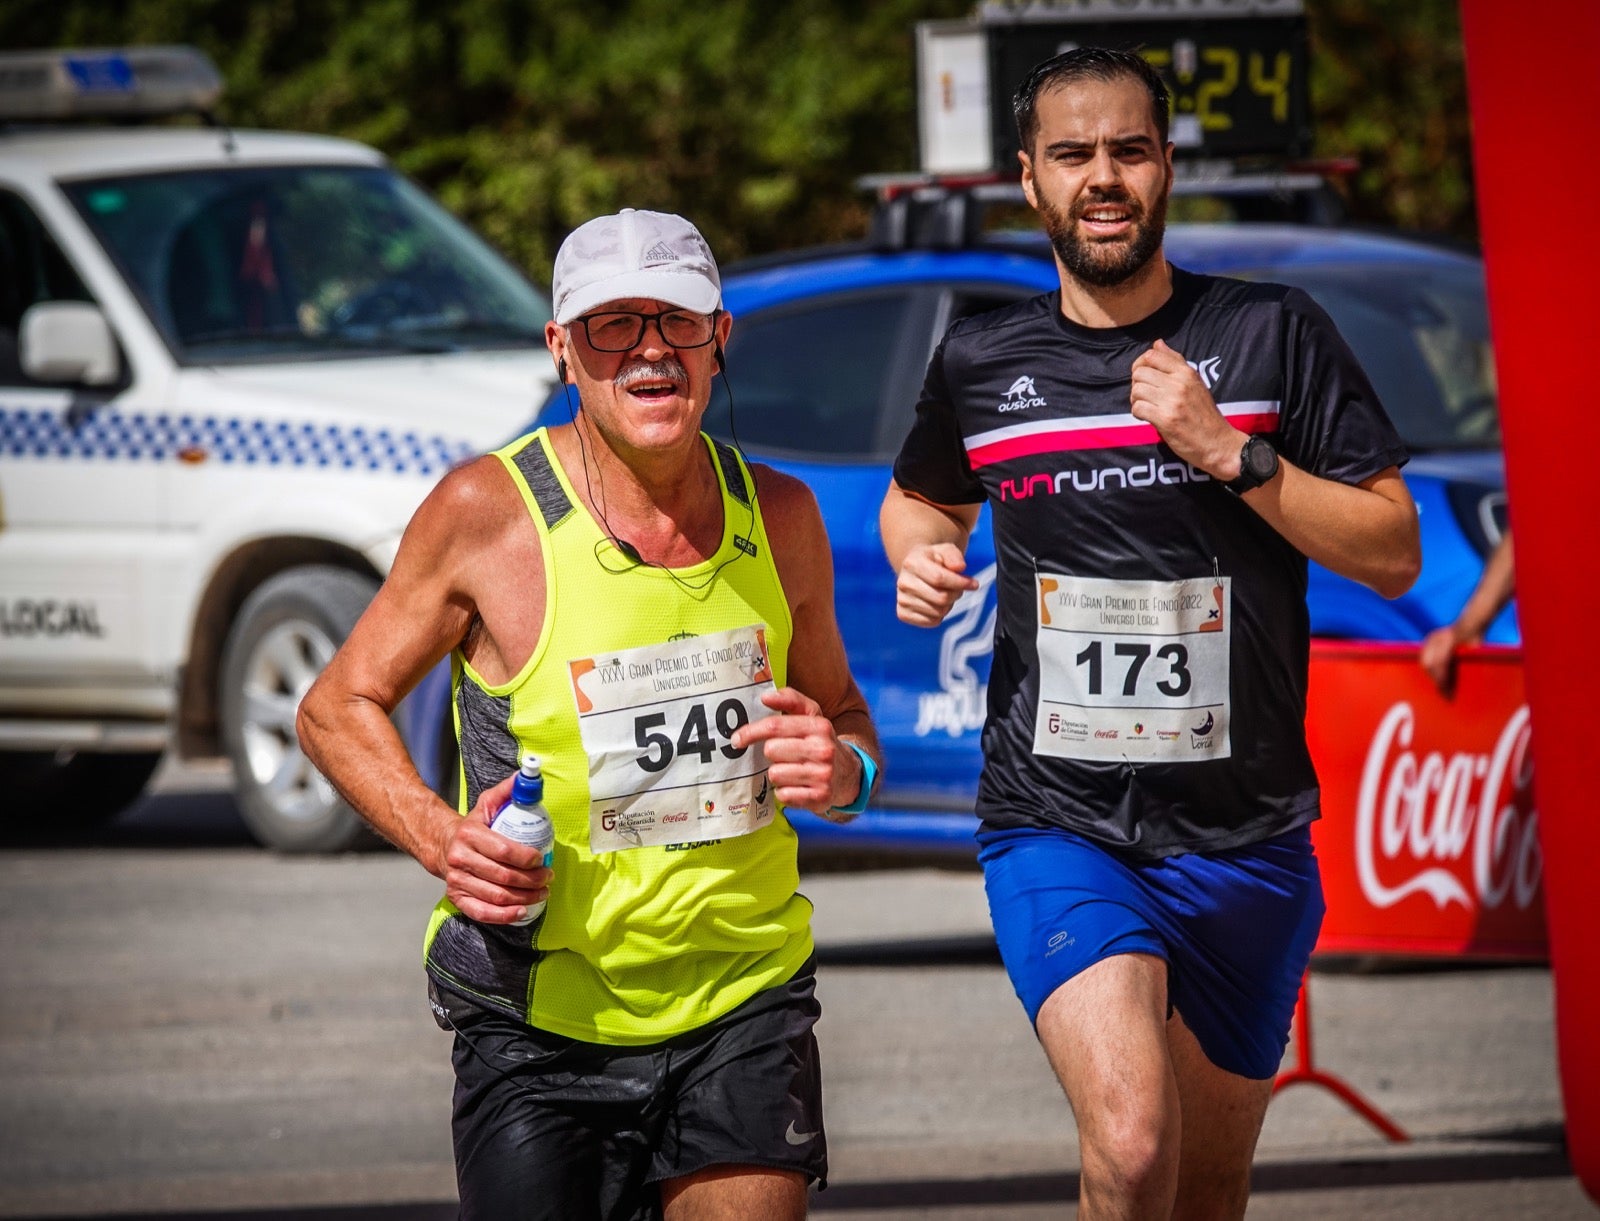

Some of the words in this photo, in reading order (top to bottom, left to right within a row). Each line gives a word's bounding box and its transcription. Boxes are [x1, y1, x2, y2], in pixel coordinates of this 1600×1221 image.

[998, 397, 1047, 413] austral
[1059, 592, 1077, 607] XXXV
[1080, 594, 1102, 609] GRAN
[1105, 596, 1136, 611] PREMIO
[1139, 600, 1149, 611] DE
[1153, 598, 1179, 612] FONDO
[1180, 594, 1202, 611] 2022
[0, 598, 108, 638] LOCAL
[1100, 612, 1135, 625] UNIVERSO
[1137, 612, 1159, 625] LORCA
[599, 665, 625, 685] XXXV
[628, 663, 653, 680] GRAN
[655, 657, 690, 675] PREMIO
[692, 652, 704, 668] DE
[706, 648, 733, 665] FONDO
[734, 640, 752, 660] 2022
[1076, 641, 1192, 697] 173
[653, 674, 691, 693] UNIVERSO
[692, 670, 718, 686] LORCA
[634, 698, 750, 772] 549
[618, 810, 655, 820] Diputación
[627, 818, 656, 827] Granada
